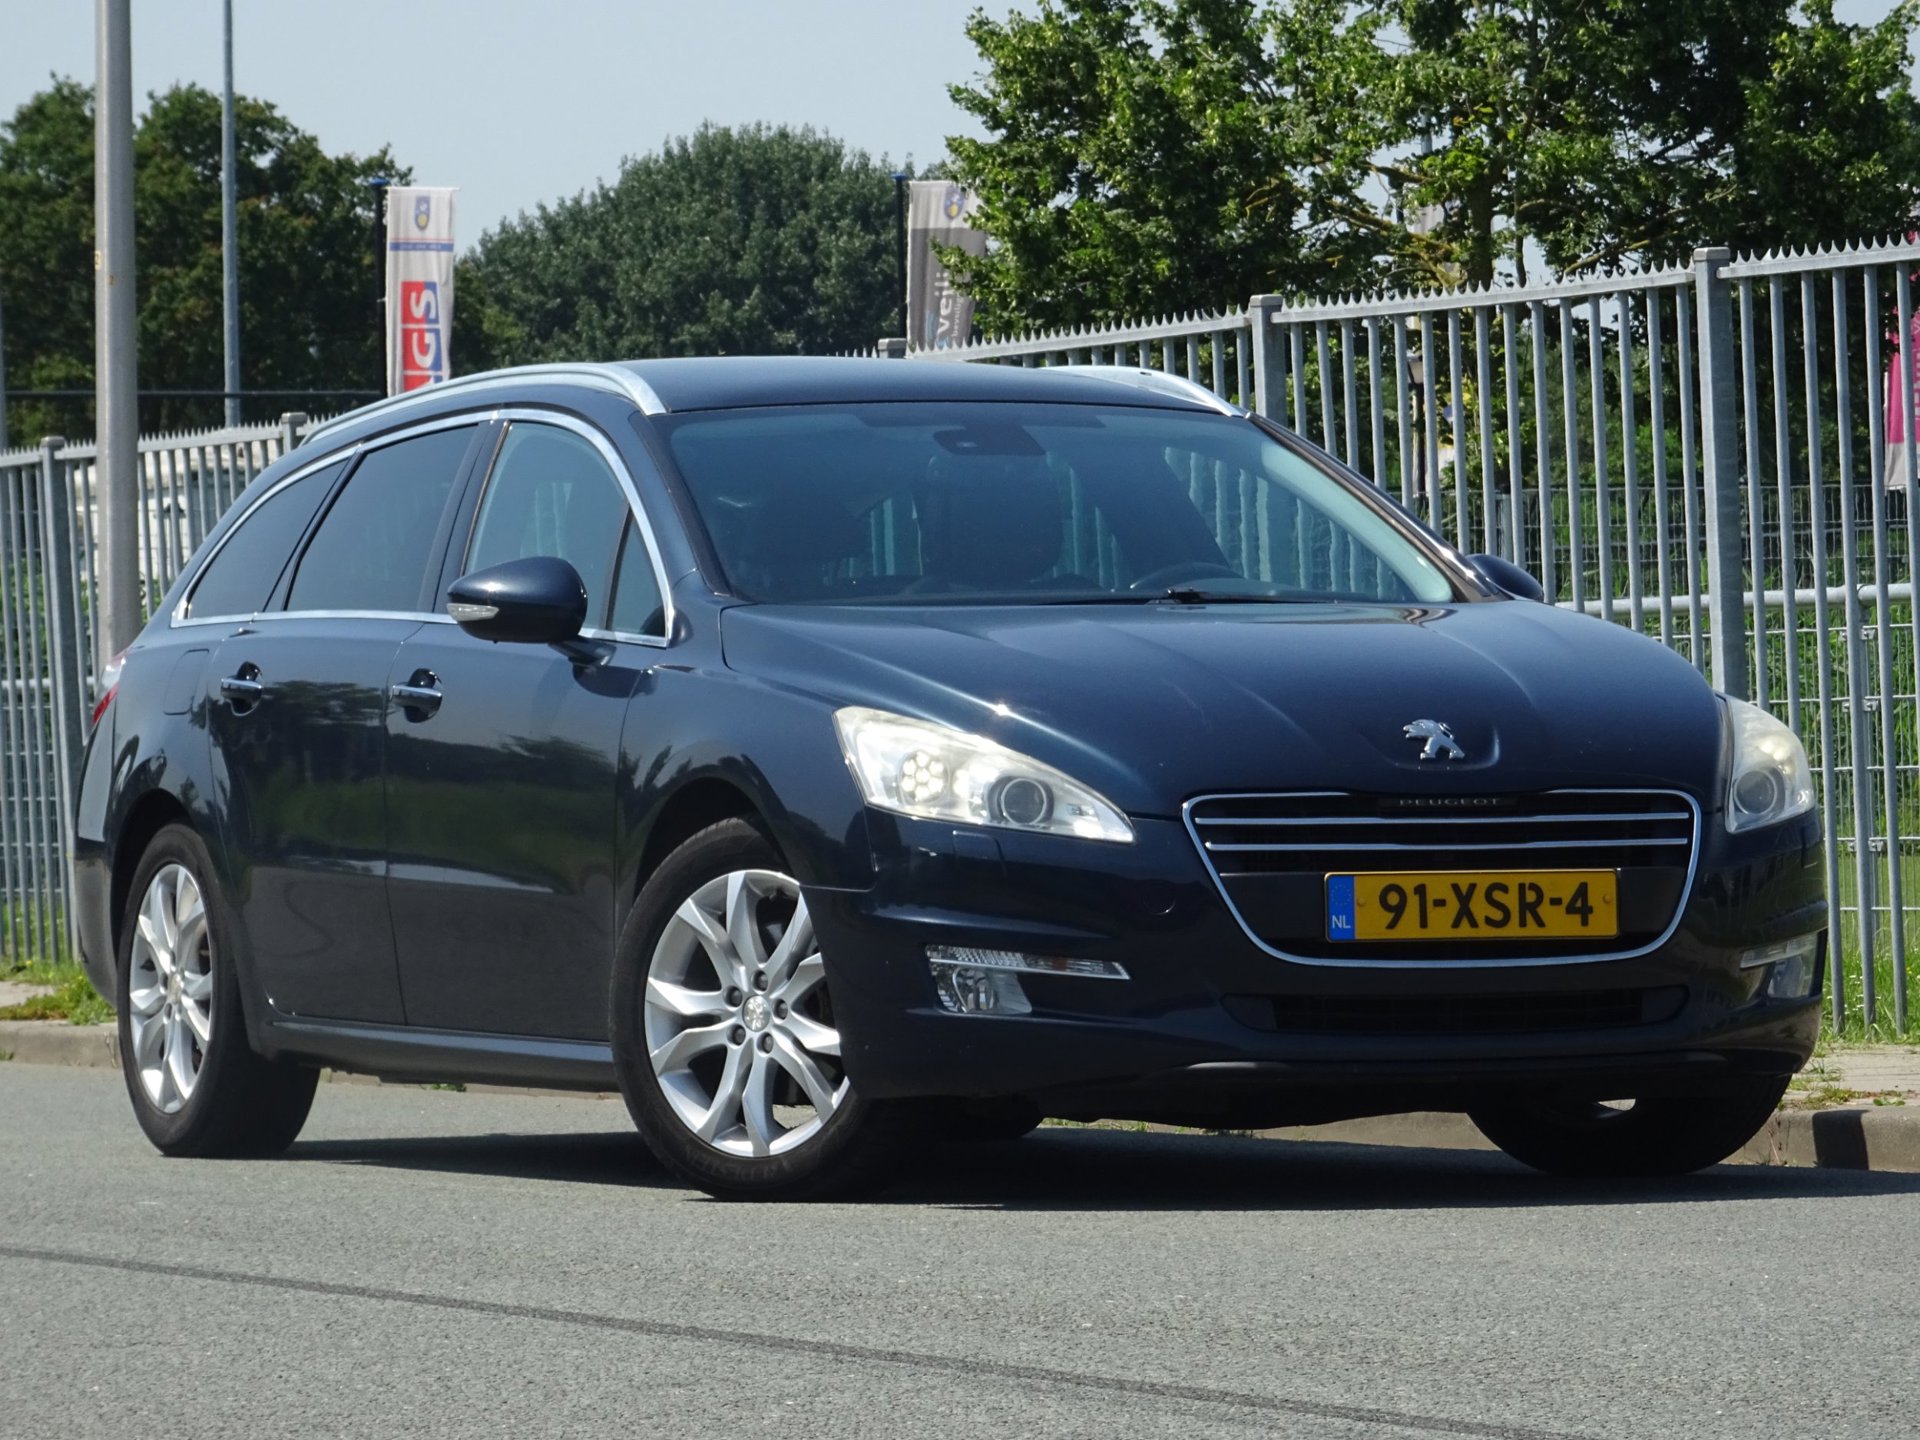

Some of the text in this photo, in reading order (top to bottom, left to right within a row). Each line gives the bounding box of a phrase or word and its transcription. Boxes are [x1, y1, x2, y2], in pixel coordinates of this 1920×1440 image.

[410, 290, 437, 385] GS
[1399, 798, 1501, 806] PEUGEOT
[1378, 881, 1594, 930] 91-XSR-4
[1332, 915, 1351, 929] NL
